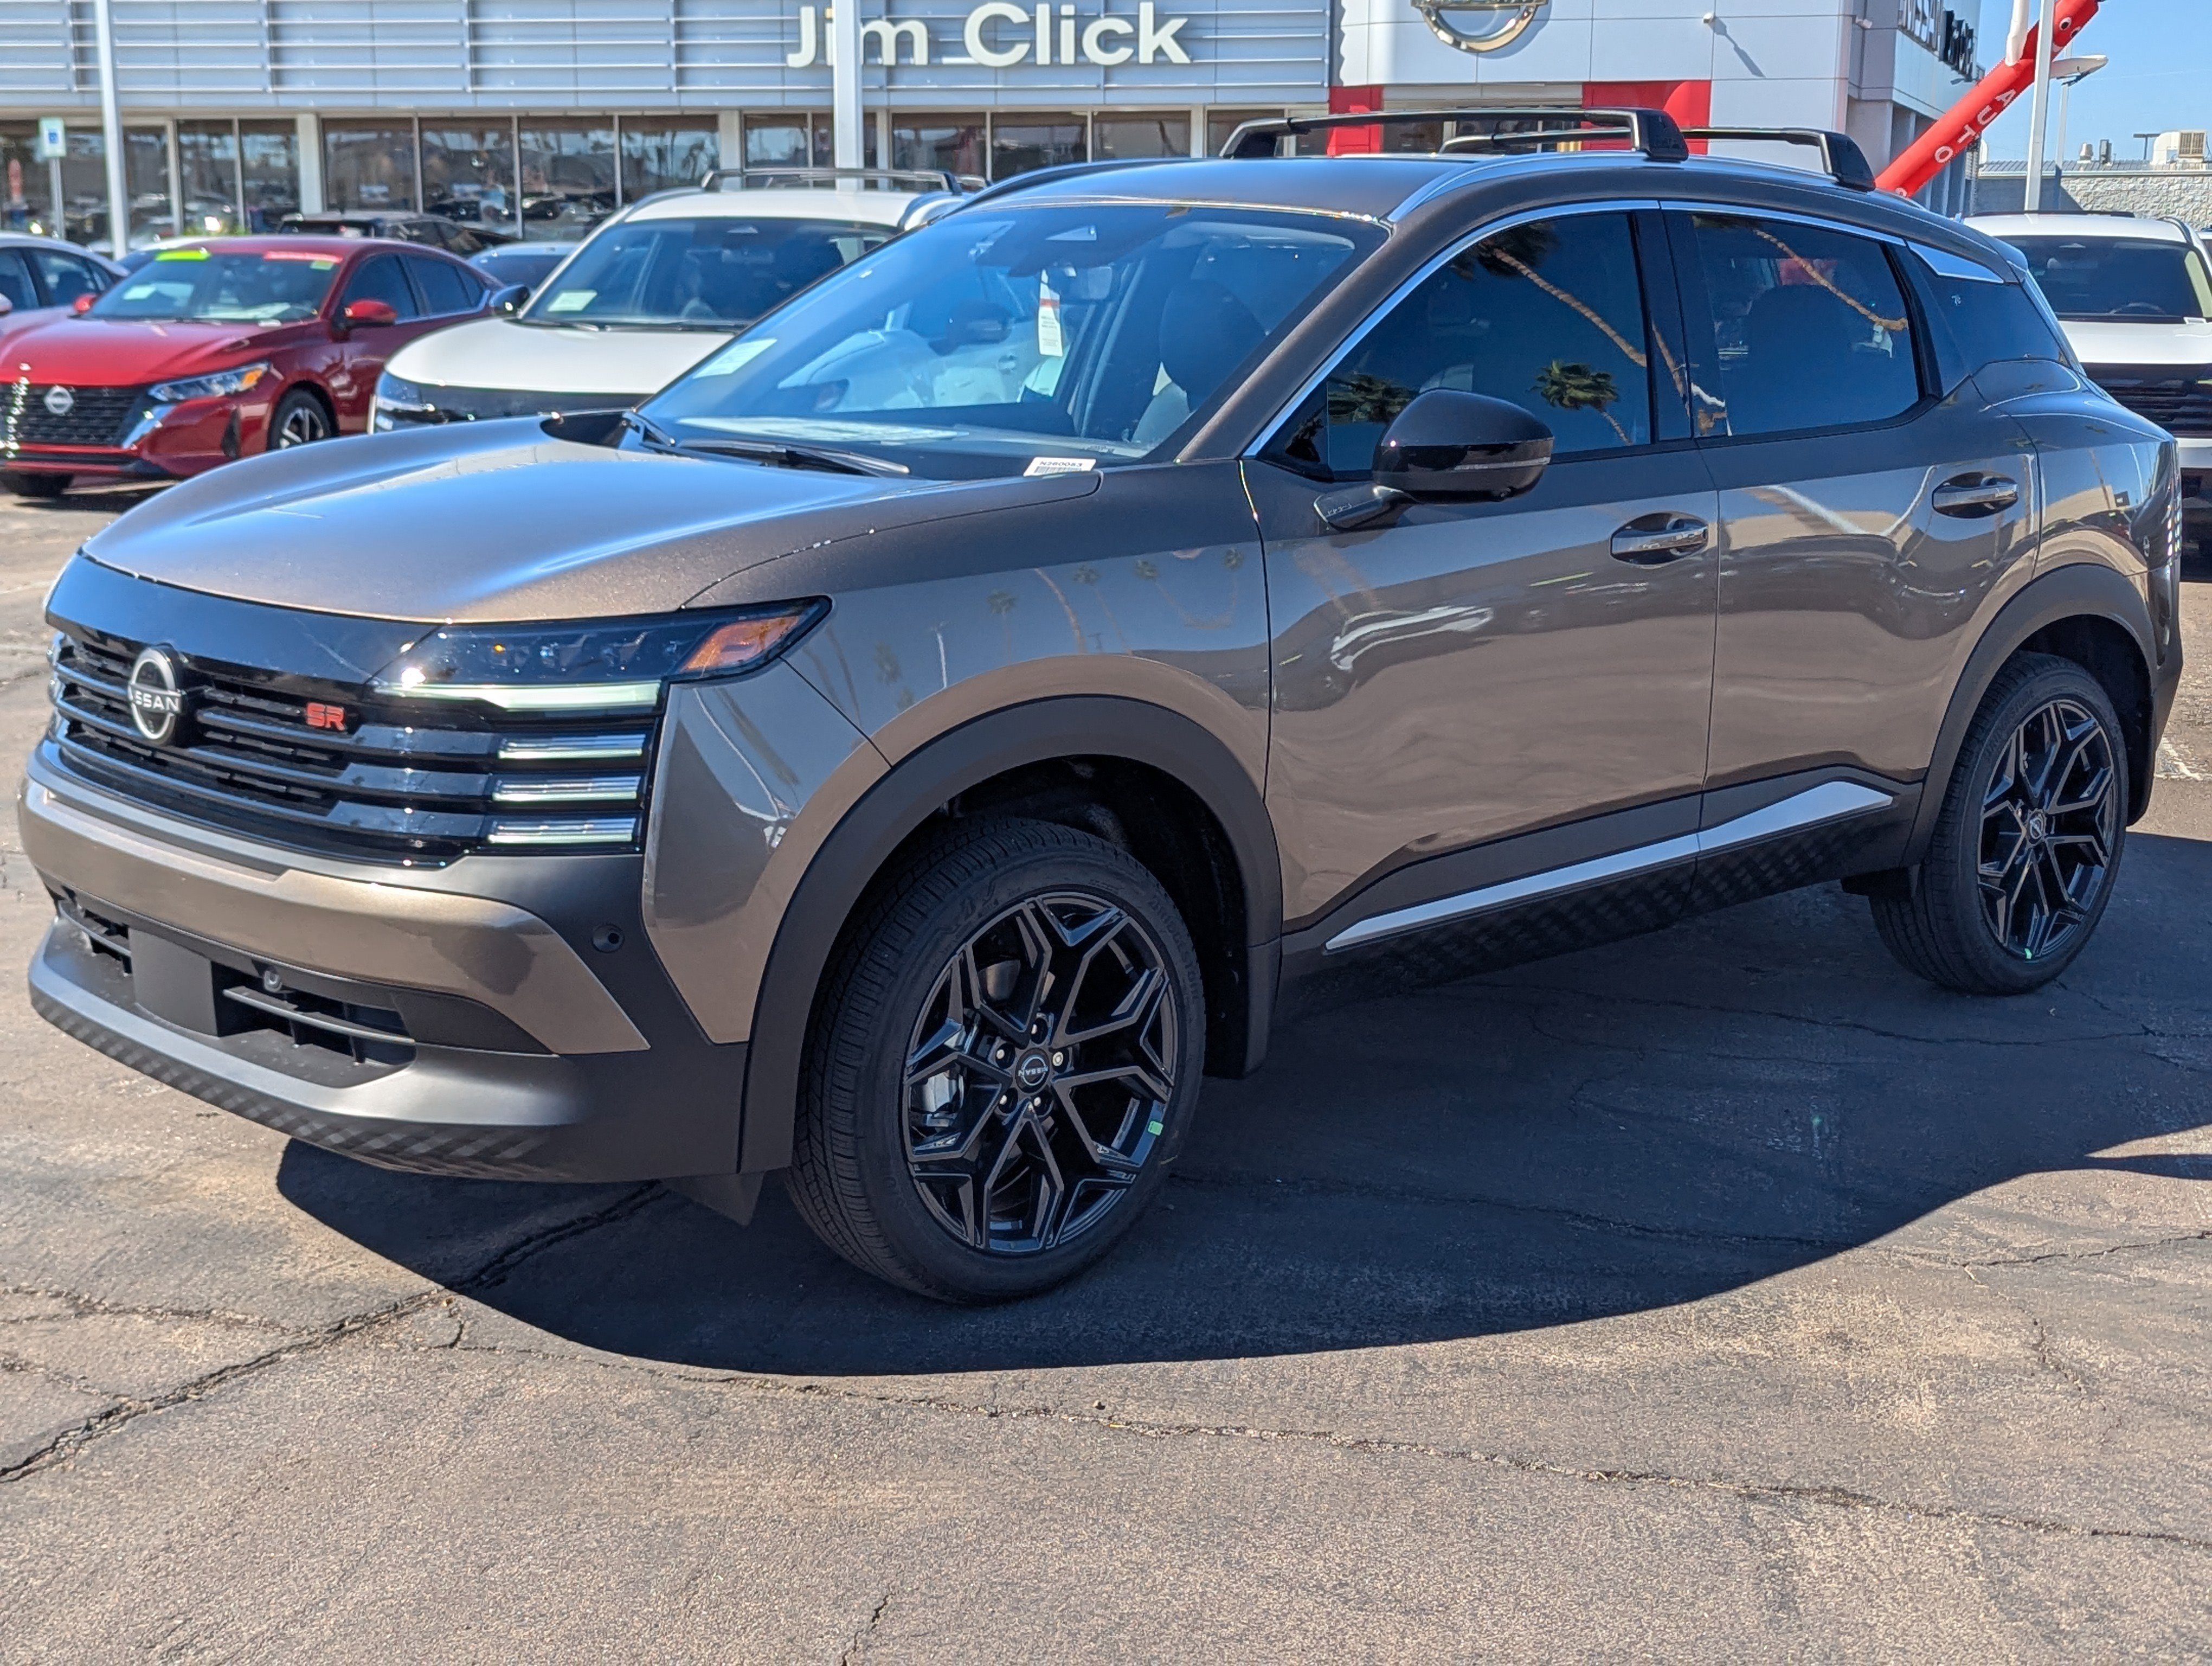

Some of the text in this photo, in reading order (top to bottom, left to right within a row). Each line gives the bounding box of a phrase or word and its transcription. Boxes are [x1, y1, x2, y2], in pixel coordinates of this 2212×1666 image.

[786, 2, 1192, 68] Jim Click
[1934, 88, 2016, 164] AUTO
[306, 702, 345, 731] SR
